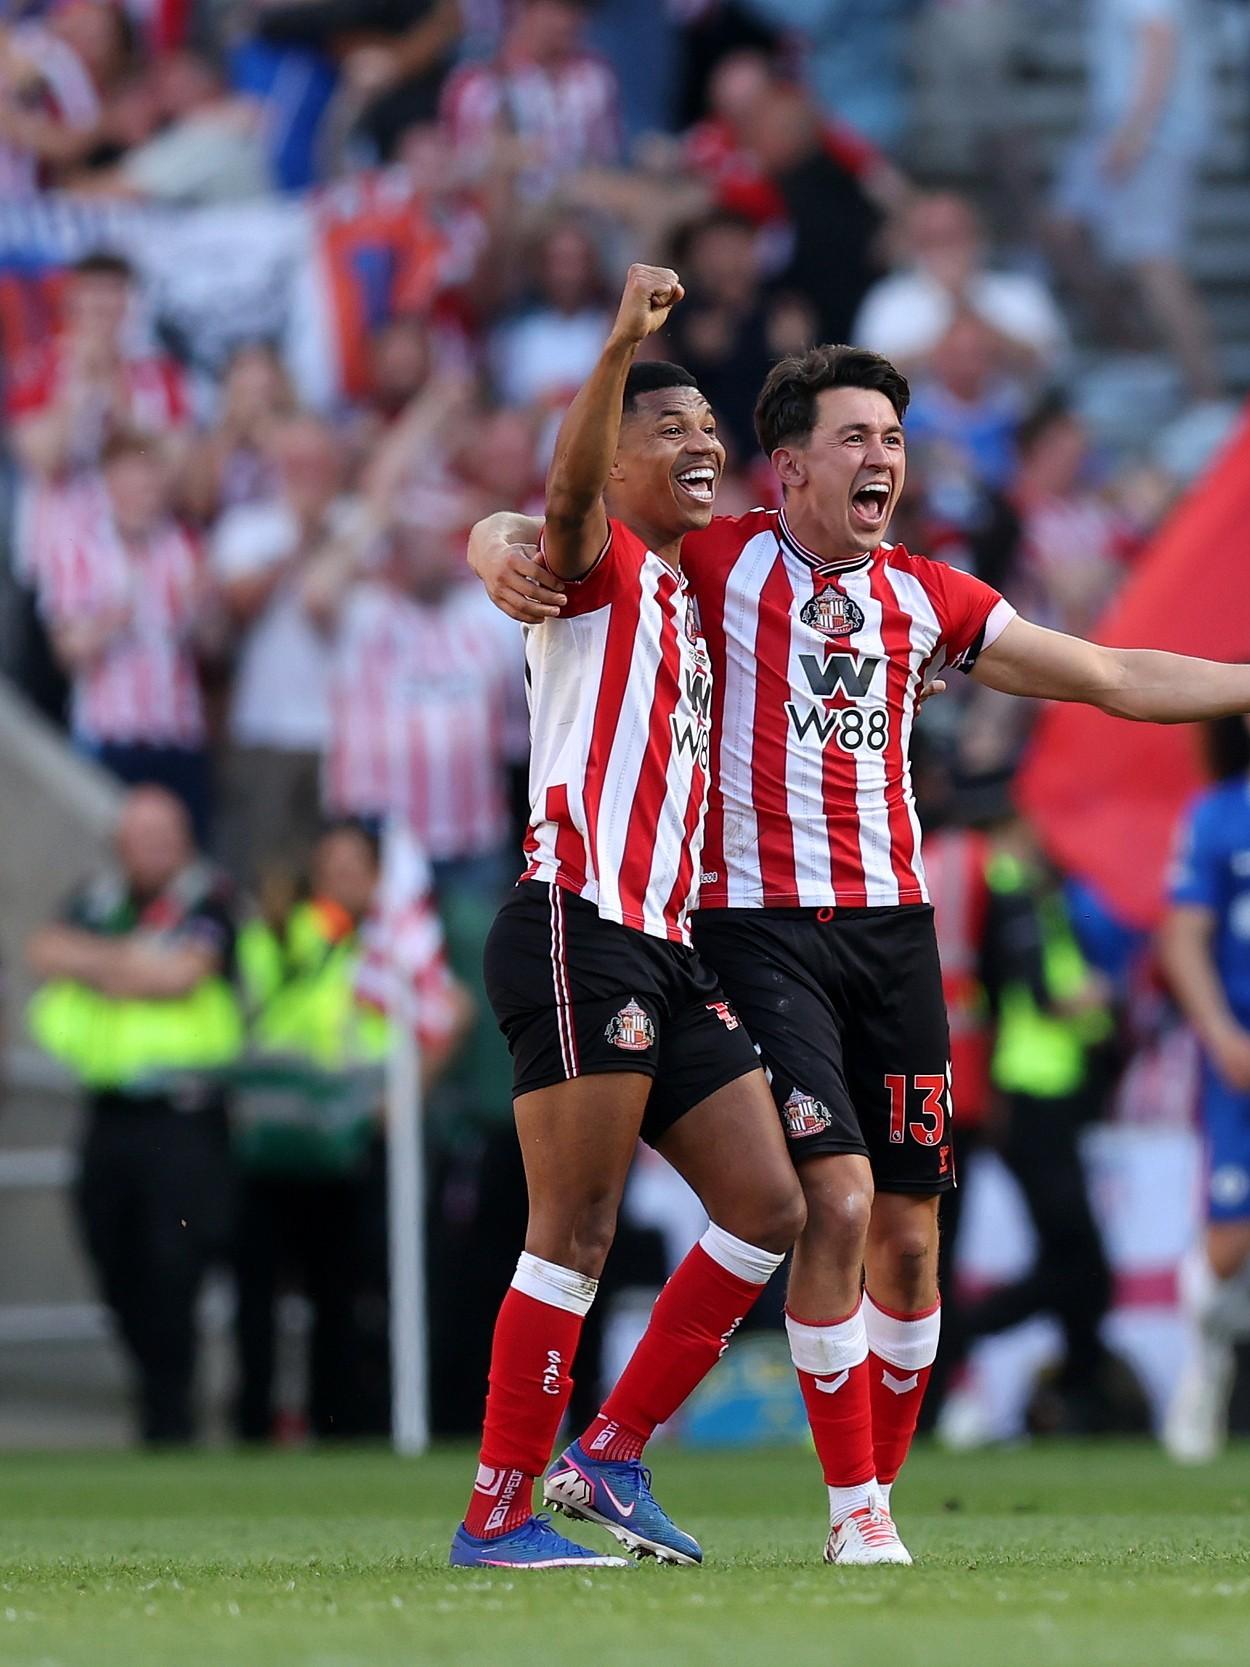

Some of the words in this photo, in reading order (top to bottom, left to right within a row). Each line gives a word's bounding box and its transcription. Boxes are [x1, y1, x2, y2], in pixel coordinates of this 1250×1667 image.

[800, 655, 881, 697] W
[788, 704, 887, 750] W88
[884, 1074, 945, 1146] 13
[543, 1350, 562, 1395] SAFC
